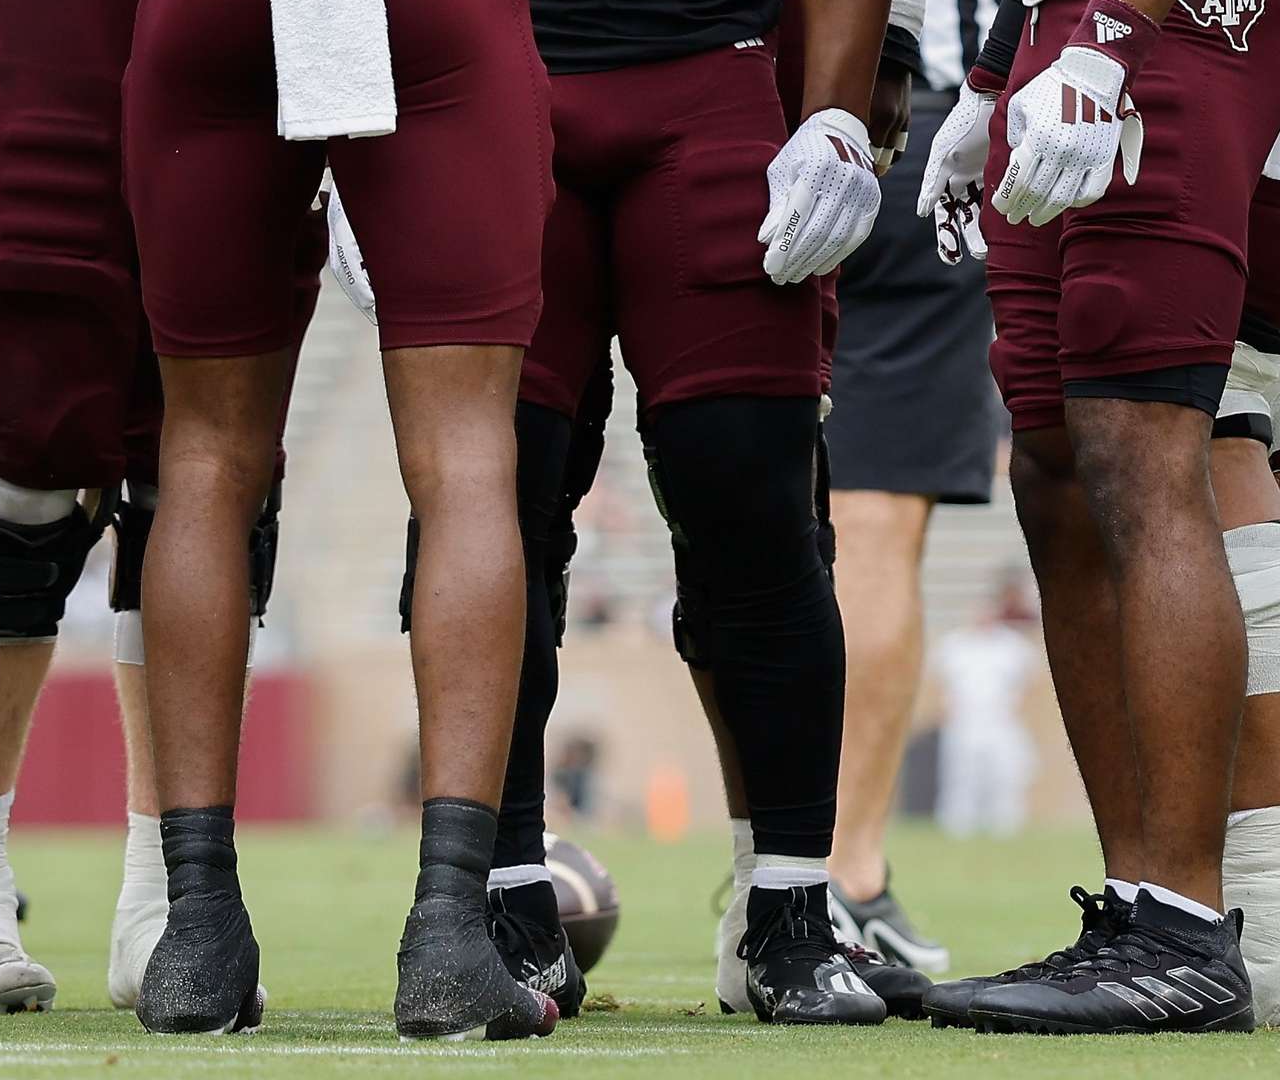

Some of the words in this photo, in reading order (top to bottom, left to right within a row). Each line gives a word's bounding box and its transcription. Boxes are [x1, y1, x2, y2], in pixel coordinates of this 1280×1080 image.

[1093, 11, 1132, 35] adidas
[1001, 160, 1021, 200] ADIZERO
[778, 208, 801, 252] ADIZERO
[336, 245, 356, 286] ADIZERO
